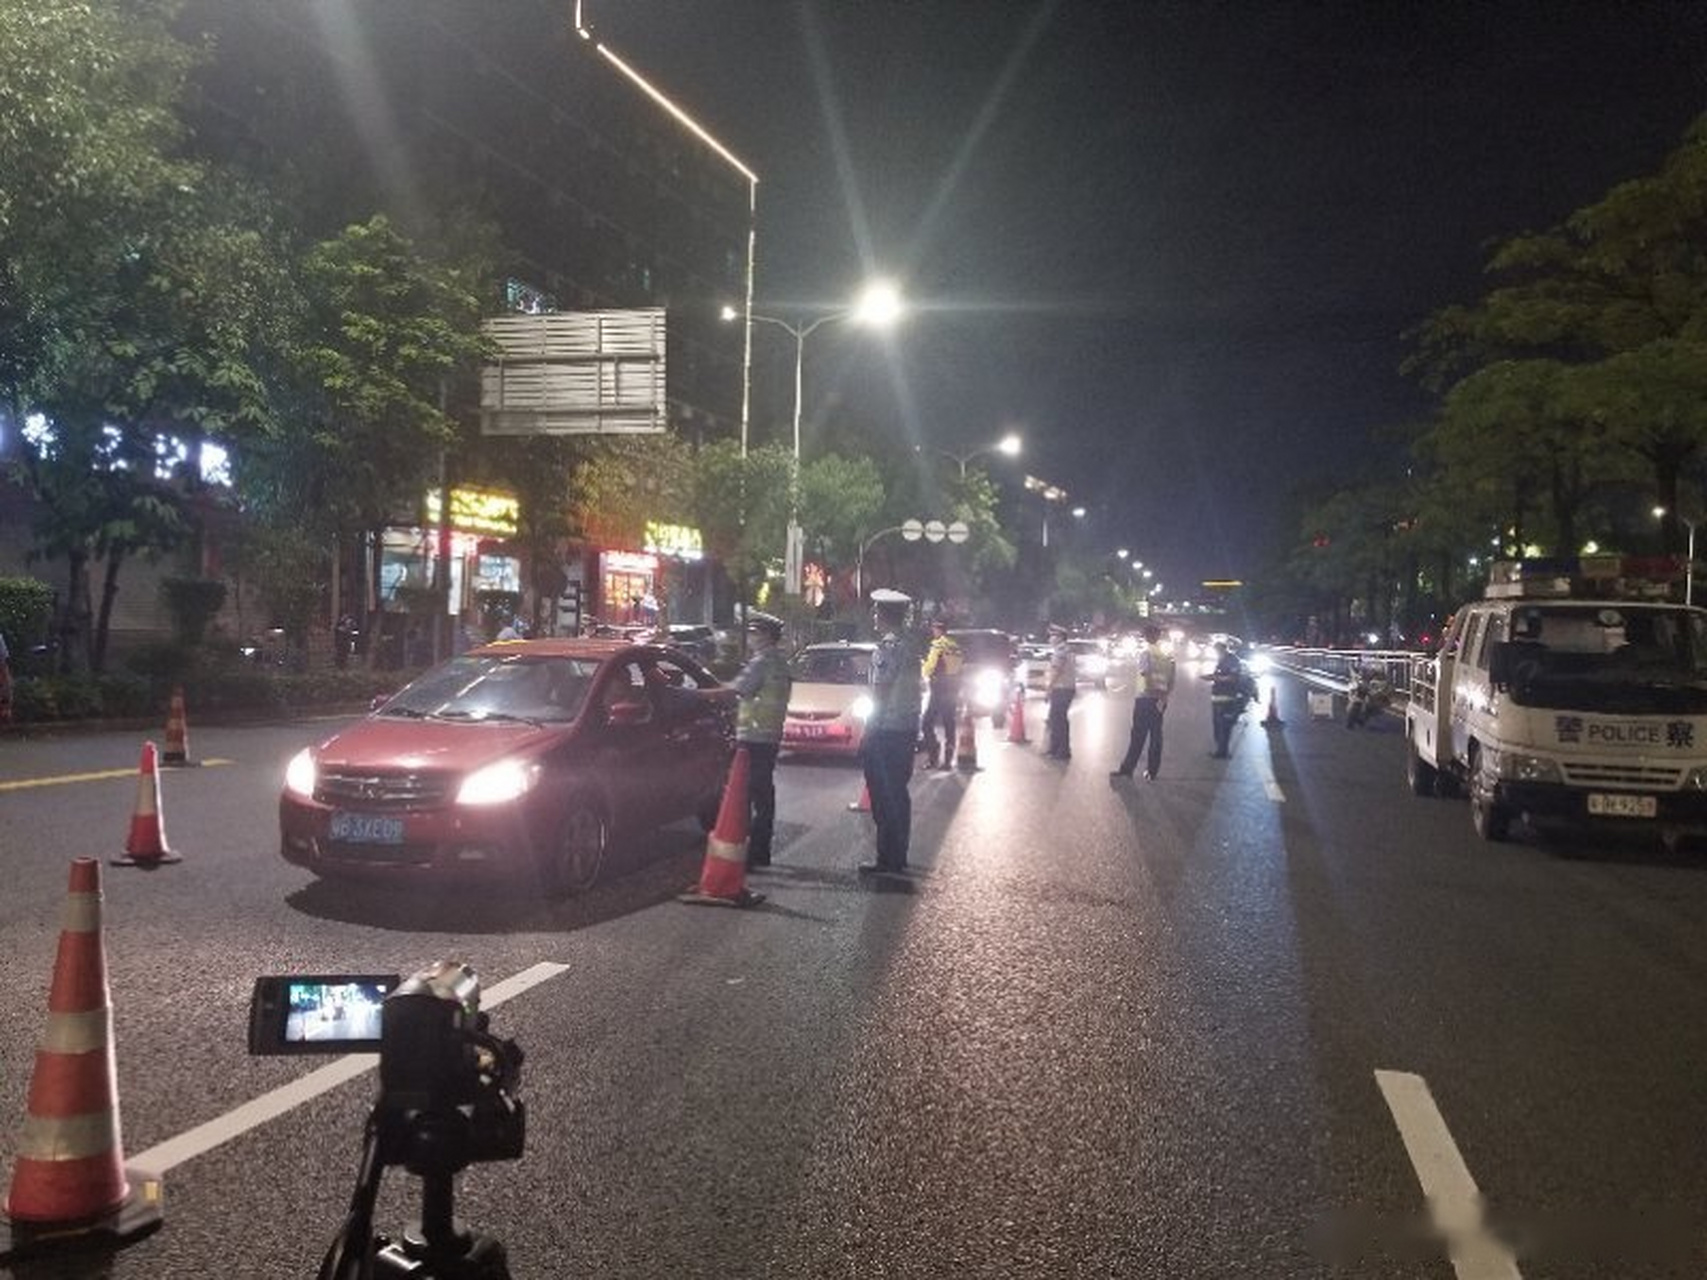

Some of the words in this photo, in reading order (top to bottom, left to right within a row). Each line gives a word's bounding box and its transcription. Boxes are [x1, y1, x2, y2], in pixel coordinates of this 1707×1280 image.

[1555, 716, 1583, 743] 警
[1588, 724, 1660, 743] POLICE
[1667, 720, 1694, 748] 察
